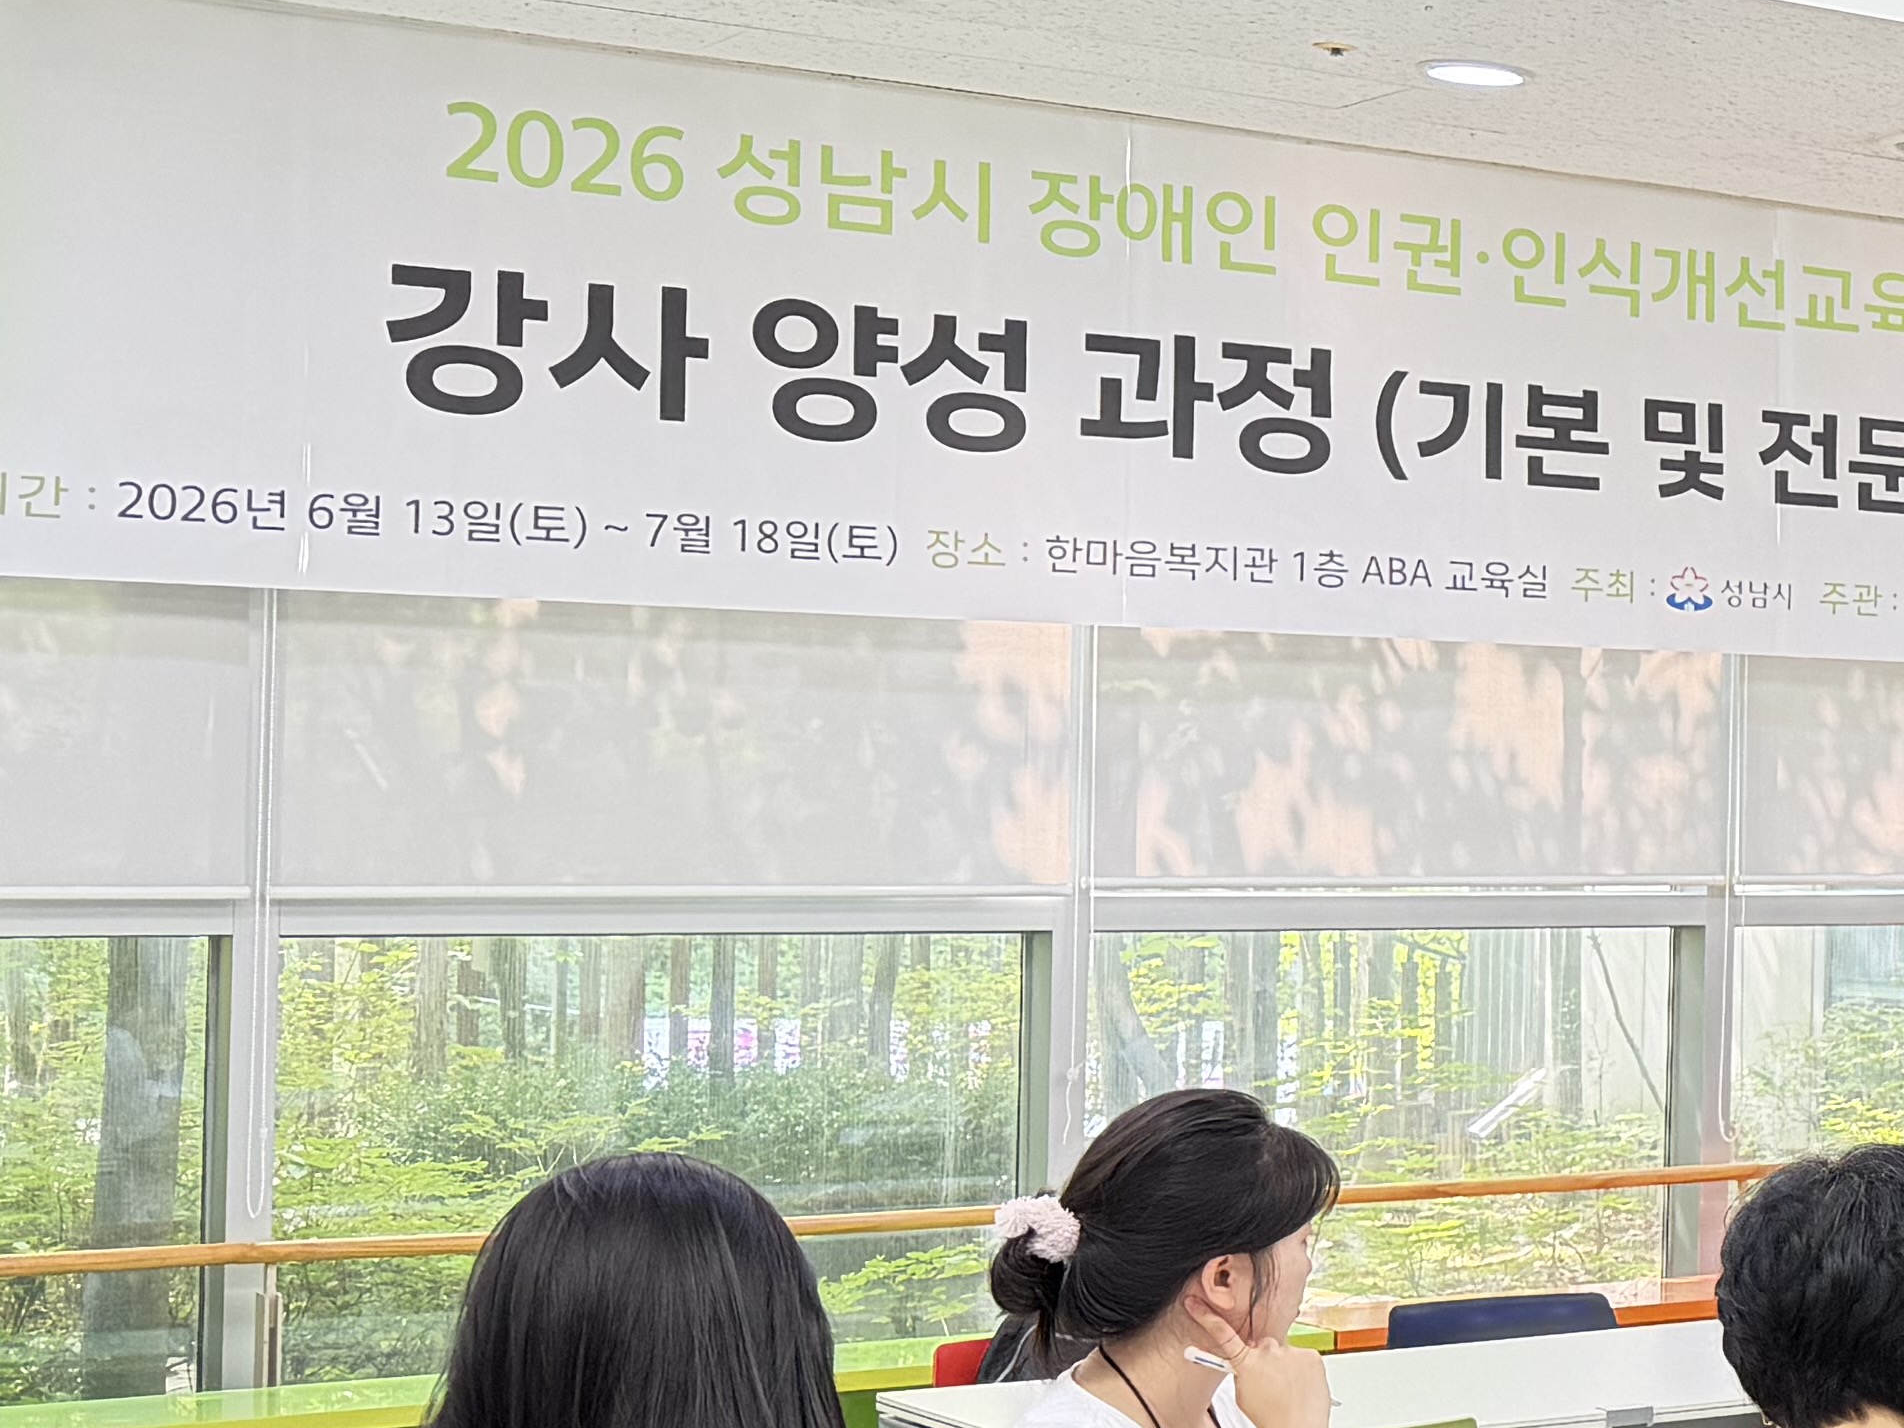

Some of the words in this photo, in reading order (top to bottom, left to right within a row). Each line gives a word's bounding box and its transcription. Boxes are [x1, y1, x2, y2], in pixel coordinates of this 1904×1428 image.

[447, 102, 684, 201] 2026
[717, 134, 991, 243] 성남시
[1029, 171, 1276, 275] 장애인
[386, 264, 709, 422] 강사
[753, 299, 1027, 452] 양성
[1081, 333, 1331, 474] 과정
[1376, 371, 1609, 490] (기본
[1644, 399, 1724, 500] 및
[118, 482, 285, 531] 2026년
[309, 494, 380, 536] 6월
[407, 500, 586, 549] 13일(토)
[646, 514, 710, 554] 7월
[734, 520, 897, 566] 18일(토)
[927, 530, 1005, 568] 장소
[1046, 535, 1277, 583] 한마음복지관
[1294, 550, 1348, 588] 1층
[1362, 556, 1431, 587] ABA
[1445, 561, 1546, 598] 교육실
[1572, 568, 1633, 603] 주최
[1721, 580, 1791, 610] 성남시
[1820, 583, 1882, 616] 주관
